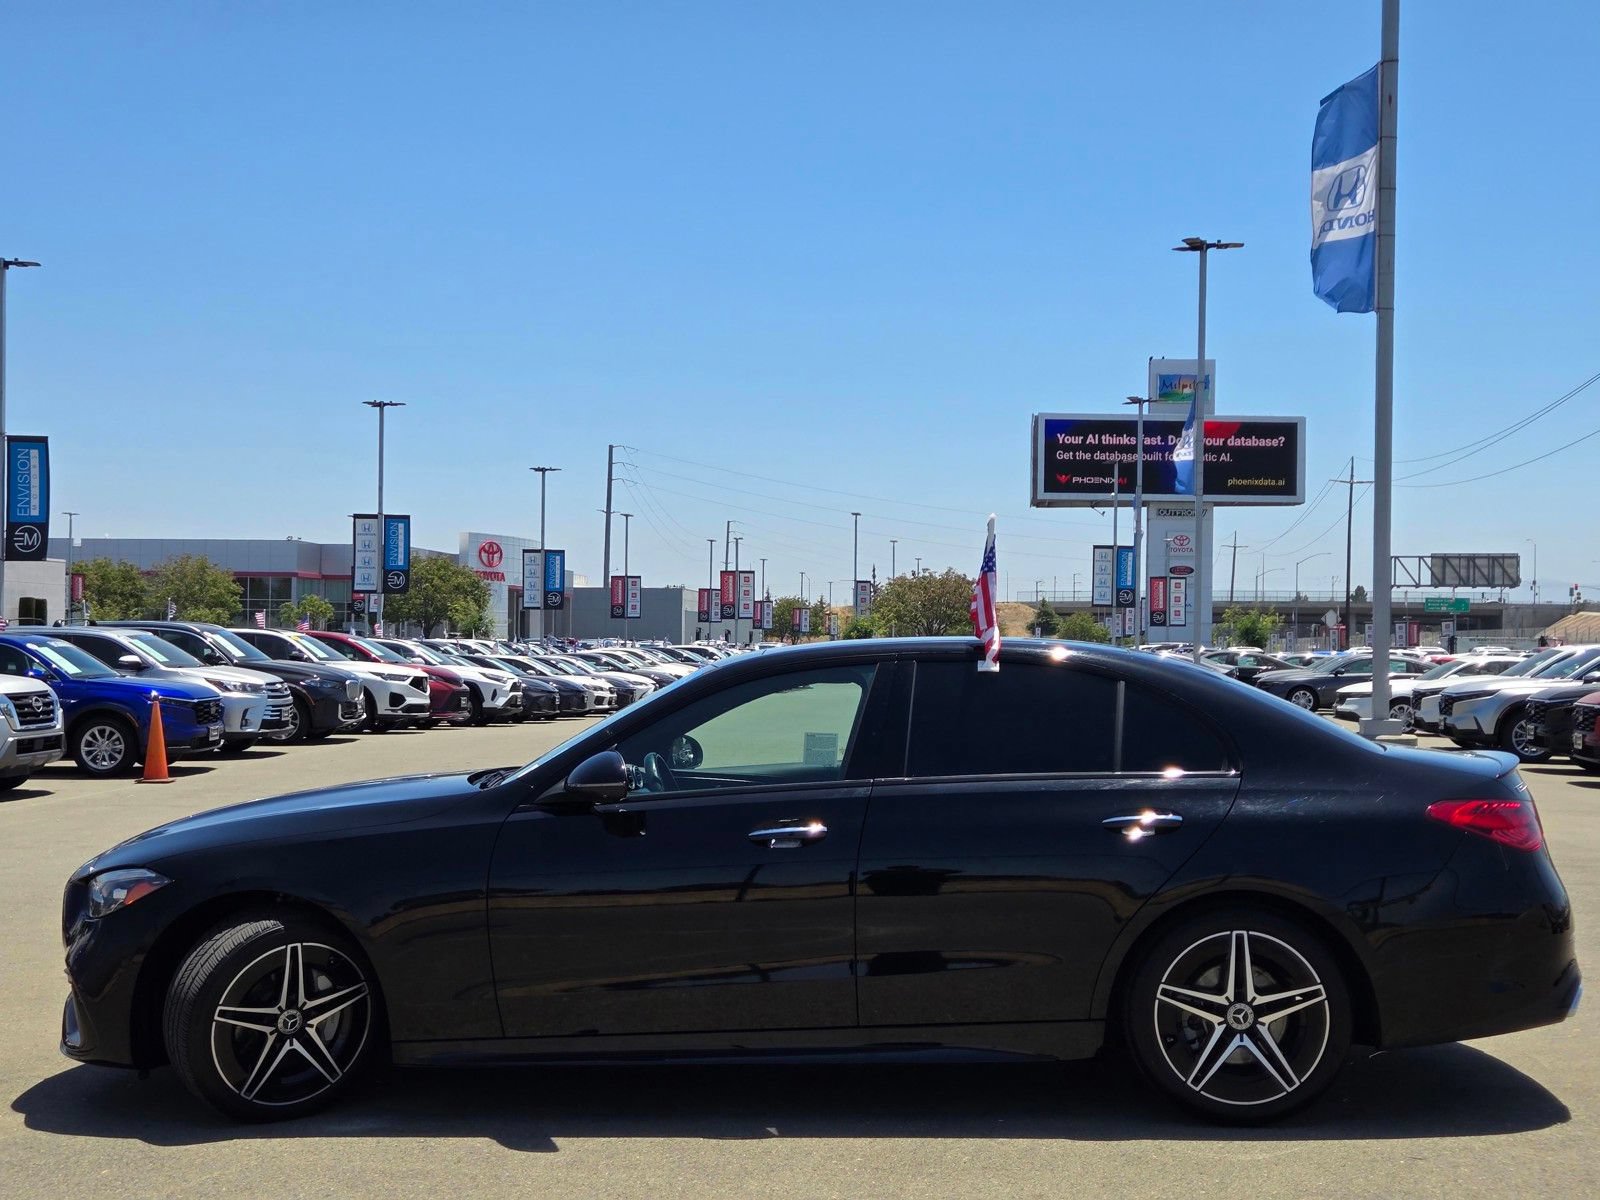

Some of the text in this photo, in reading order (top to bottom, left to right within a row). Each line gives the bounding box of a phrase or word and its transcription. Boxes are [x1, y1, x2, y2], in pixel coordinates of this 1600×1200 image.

[1056, 433, 1083, 445] Your
[1086, 434, 1098, 445] AI
[1101, 433, 1137, 445] thinks
[1227, 435, 1286, 446] database?
[1056, 450, 1073, 460] Get
[1076, 450, 1092, 460] the
[1093, 450, 1138, 460] database
[1219, 452, 1233, 462] AI.
[17, 448, 30, 516] ENVISION
[1227, 477, 1286, 487] phoenixdata.ai
[389, 522, 398, 566] ENVISION
[1120, 551, 1128, 586] ENVISION
